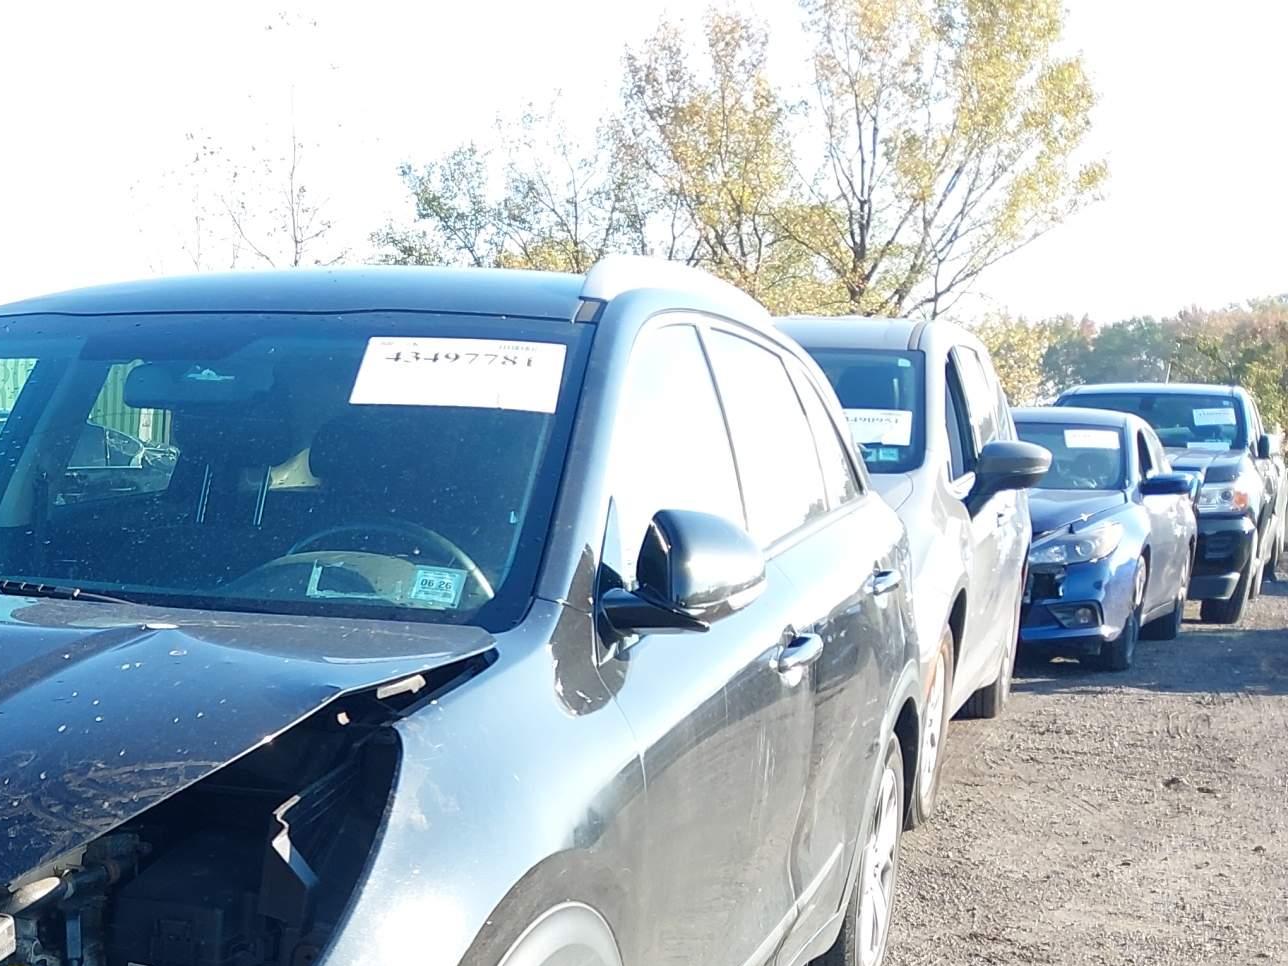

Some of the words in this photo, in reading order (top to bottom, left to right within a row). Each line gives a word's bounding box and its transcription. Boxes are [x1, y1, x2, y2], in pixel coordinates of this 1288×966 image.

[384, 351, 534, 368] 43497781
[420, 578, 434, 587] 06
[438, 580, 453, 590] 26
